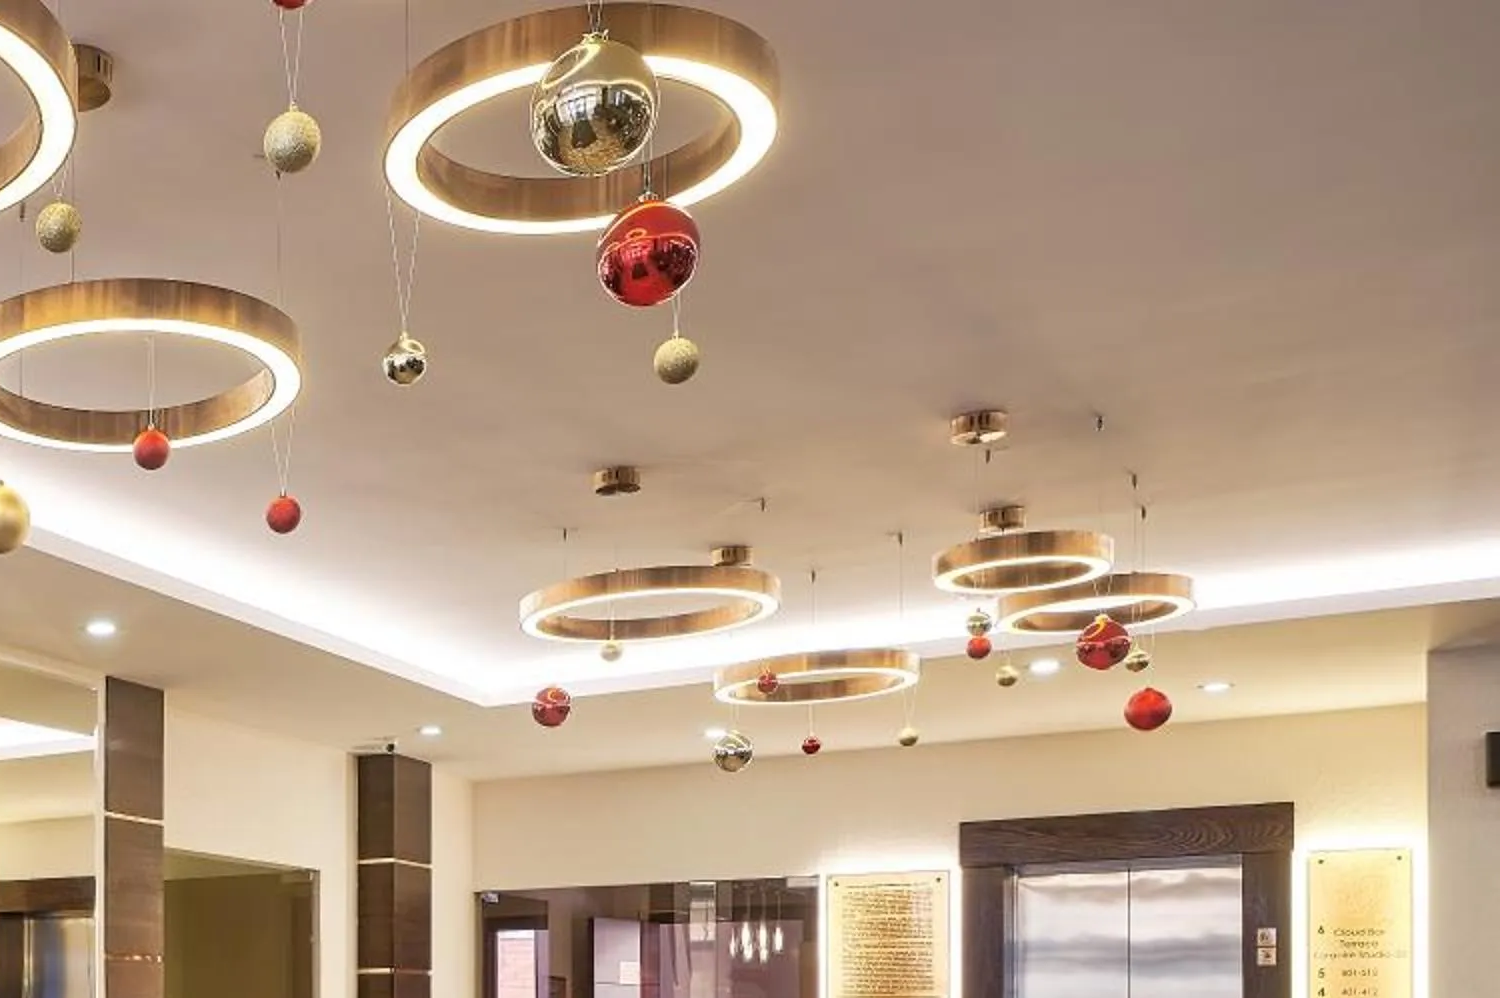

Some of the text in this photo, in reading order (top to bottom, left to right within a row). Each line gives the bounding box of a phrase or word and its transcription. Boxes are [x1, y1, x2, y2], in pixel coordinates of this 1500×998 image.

[1318, 925, 1325, 935] 6
[1318, 967, 1325, 979] 5
[1318, 986, 1325, 997] 4
